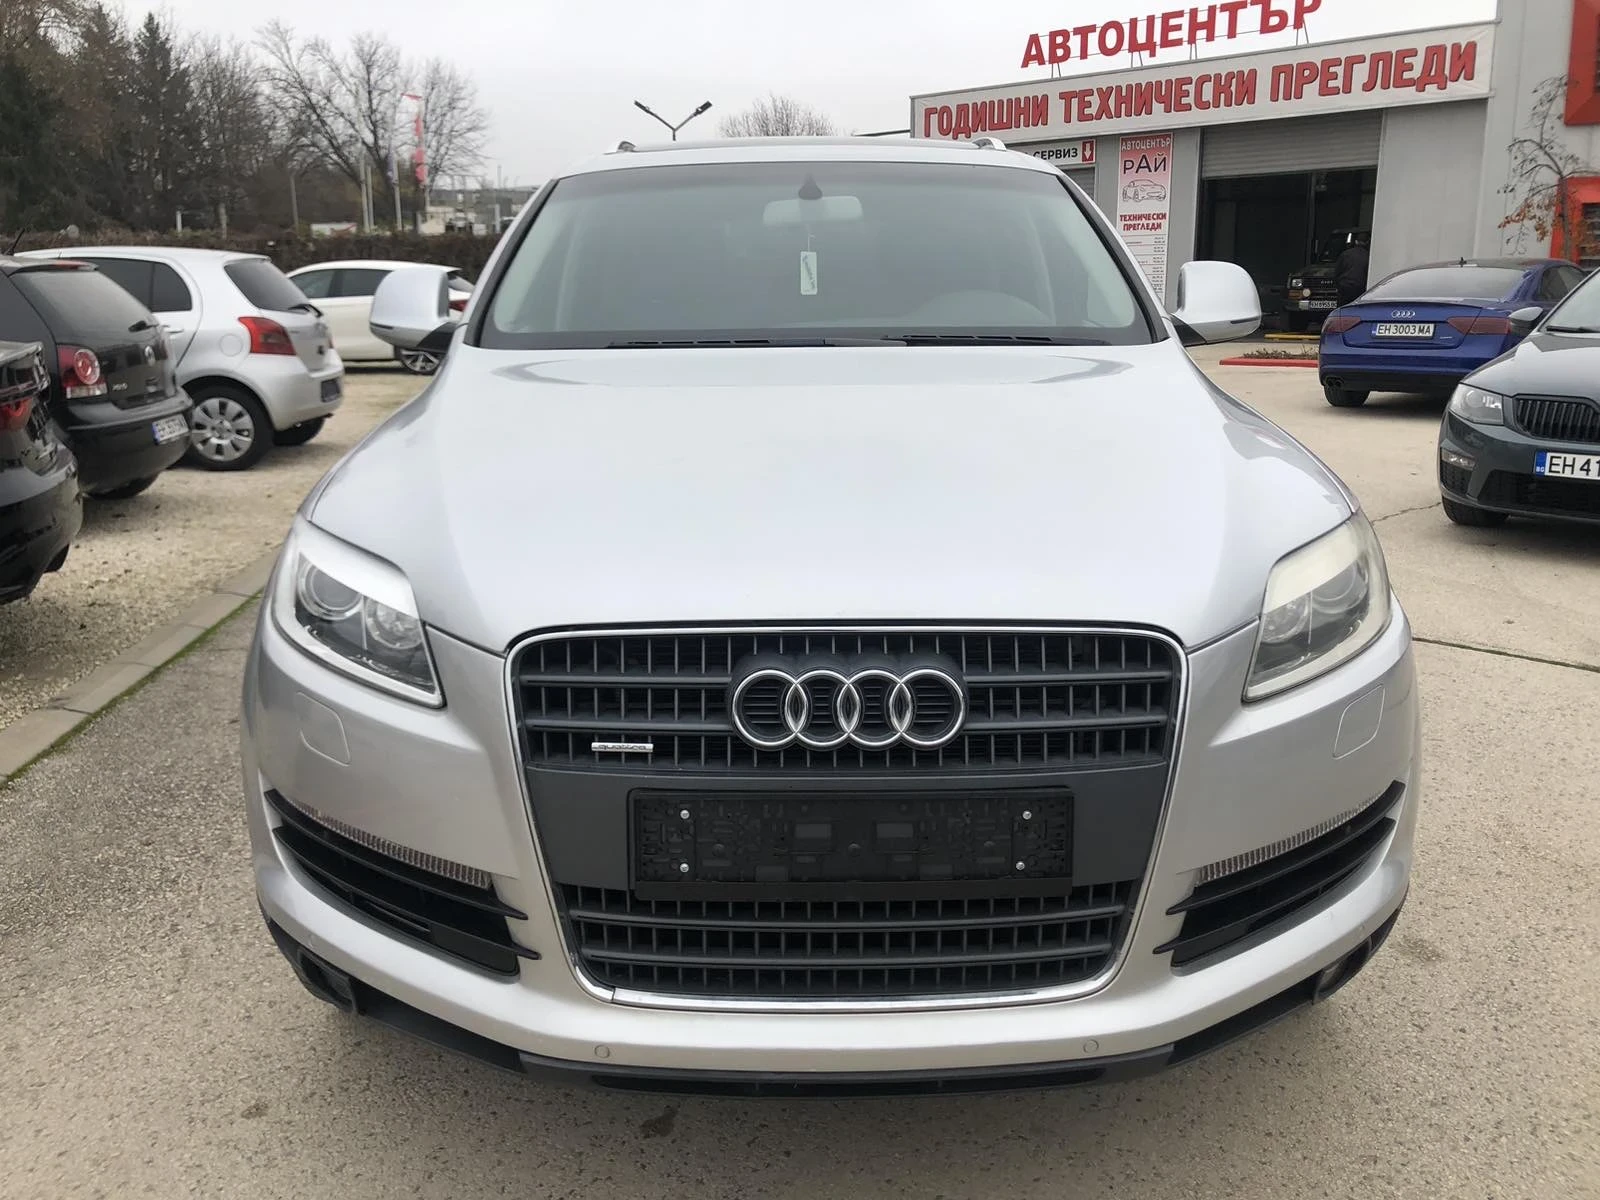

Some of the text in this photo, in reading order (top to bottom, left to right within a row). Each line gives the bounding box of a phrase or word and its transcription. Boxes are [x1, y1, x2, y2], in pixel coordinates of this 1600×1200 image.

[1021, 0, 1322, 68] АВТОЦЕНТЪР
[923, 40, 1477, 139] ГОДИШНИ ТЕХНИЧЕСКИ ПРЕГЛЕДИ
[1121, 137, 1171, 151] АВТОЦЕНТЪР
[1119, 212, 1167, 222] ТЕХНИЧЕСКИ
[1123, 222, 1162, 231] ПРЕГЛЕДИ
